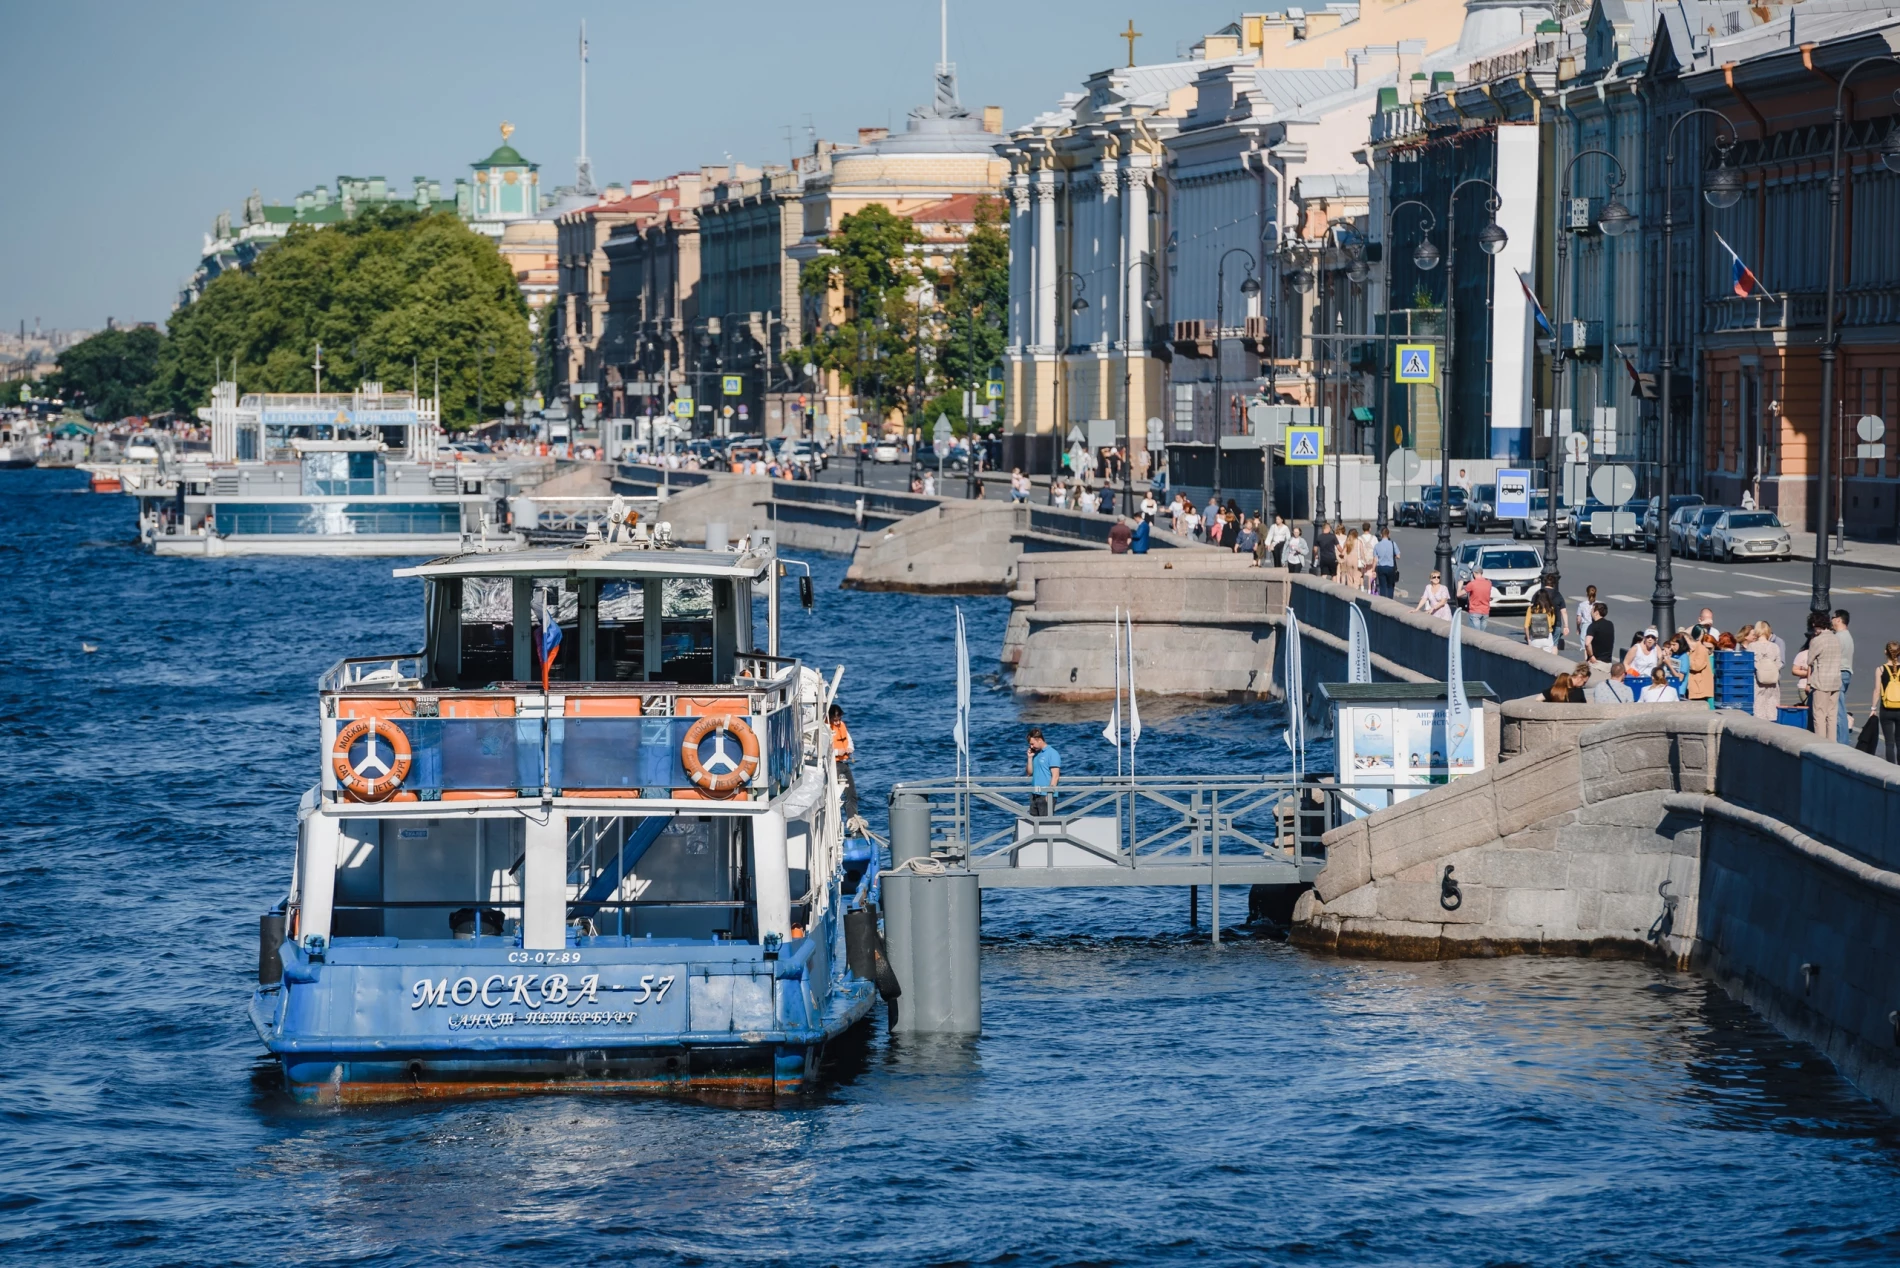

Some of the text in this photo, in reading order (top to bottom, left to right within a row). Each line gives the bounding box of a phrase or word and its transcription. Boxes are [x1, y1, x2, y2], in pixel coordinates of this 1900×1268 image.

[339, 722, 368, 749] МОСКВА
[691, 719, 724, 739] МОСКВА
[411, 973, 600, 1009] МОСКВА
